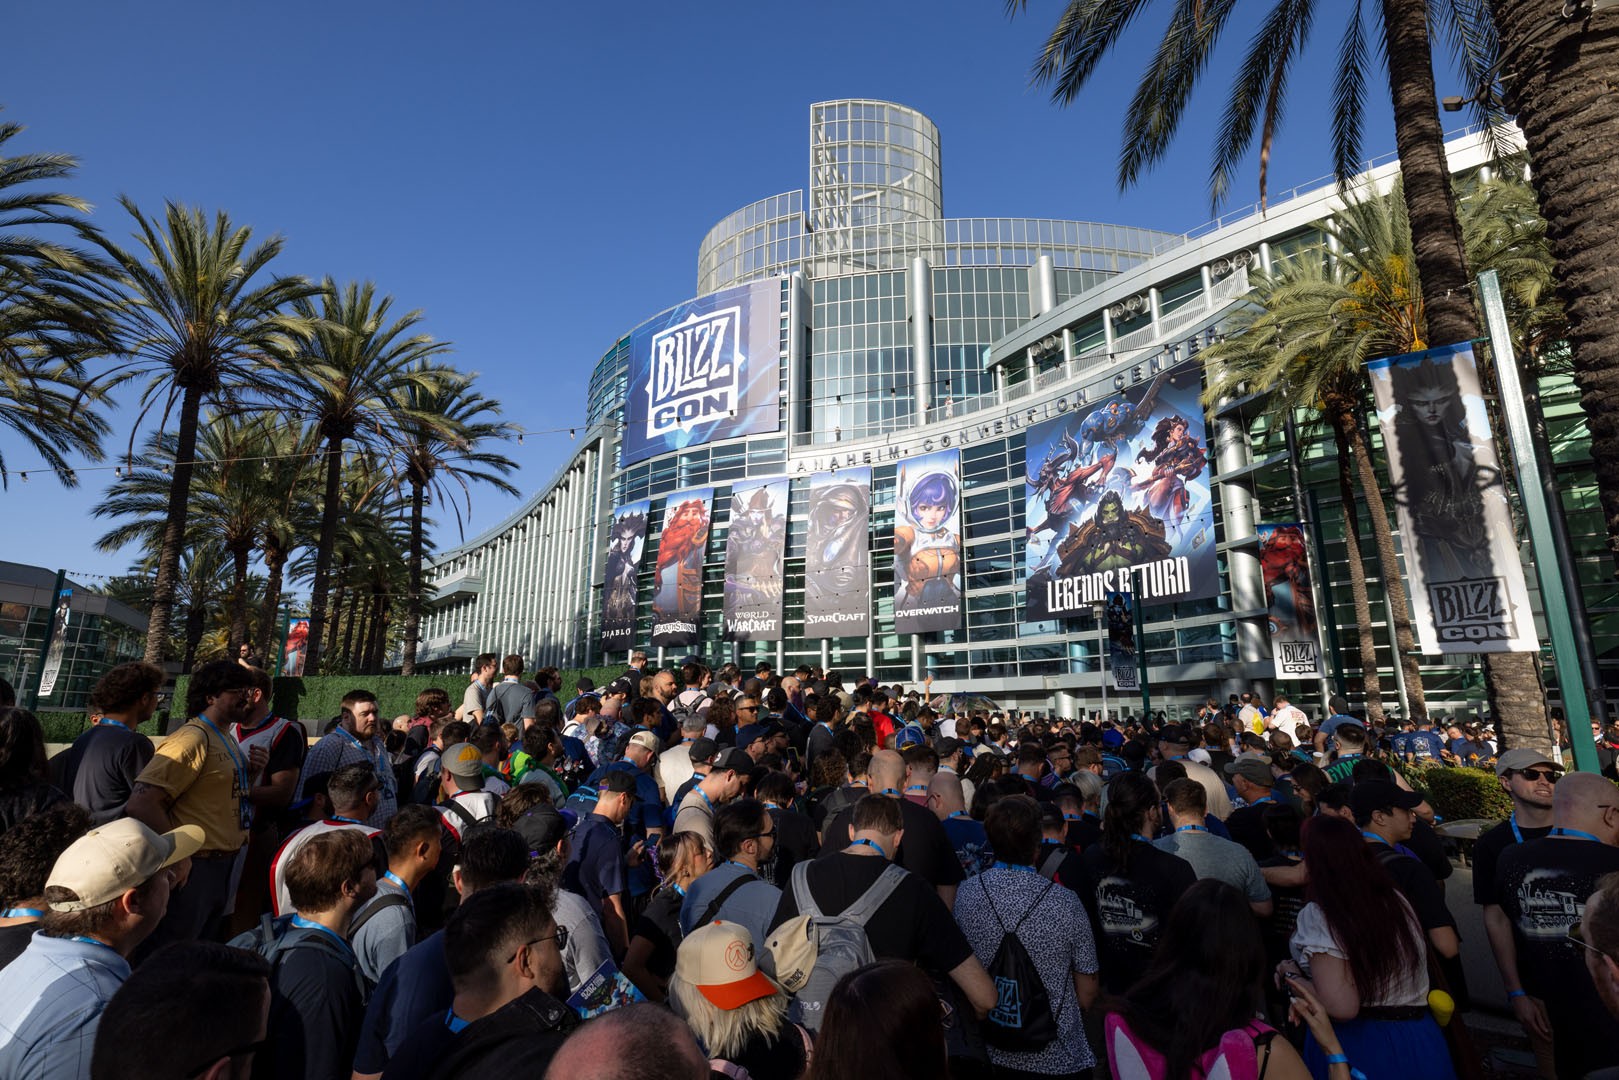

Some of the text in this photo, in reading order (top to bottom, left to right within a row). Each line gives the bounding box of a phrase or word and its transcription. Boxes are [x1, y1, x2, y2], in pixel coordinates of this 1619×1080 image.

[655, 316, 730, 402] BLIZZ
[796, 325, 1218, 473] ANAHEIM CONVENTION CENTER
[653, 390, 729, 430] CON
[1047, 569, 1115, 613] LEGENDS
[1434, 581, 1508, 623] BLIZZ
[735, 610, 770, 619] WORLD
[806, 612, 867, 625] STARCRAFT
[895, 604, 959, 618] OVERWATCH
[601, 627, 631, 639] DIABLO
[727, 619, 777, 634] WARCRAFT
[1441, 624, 1512, 640] CON
[1282, 643, 1314, 663] BLIZZ
[1285, 664, 1315, 672] CON
